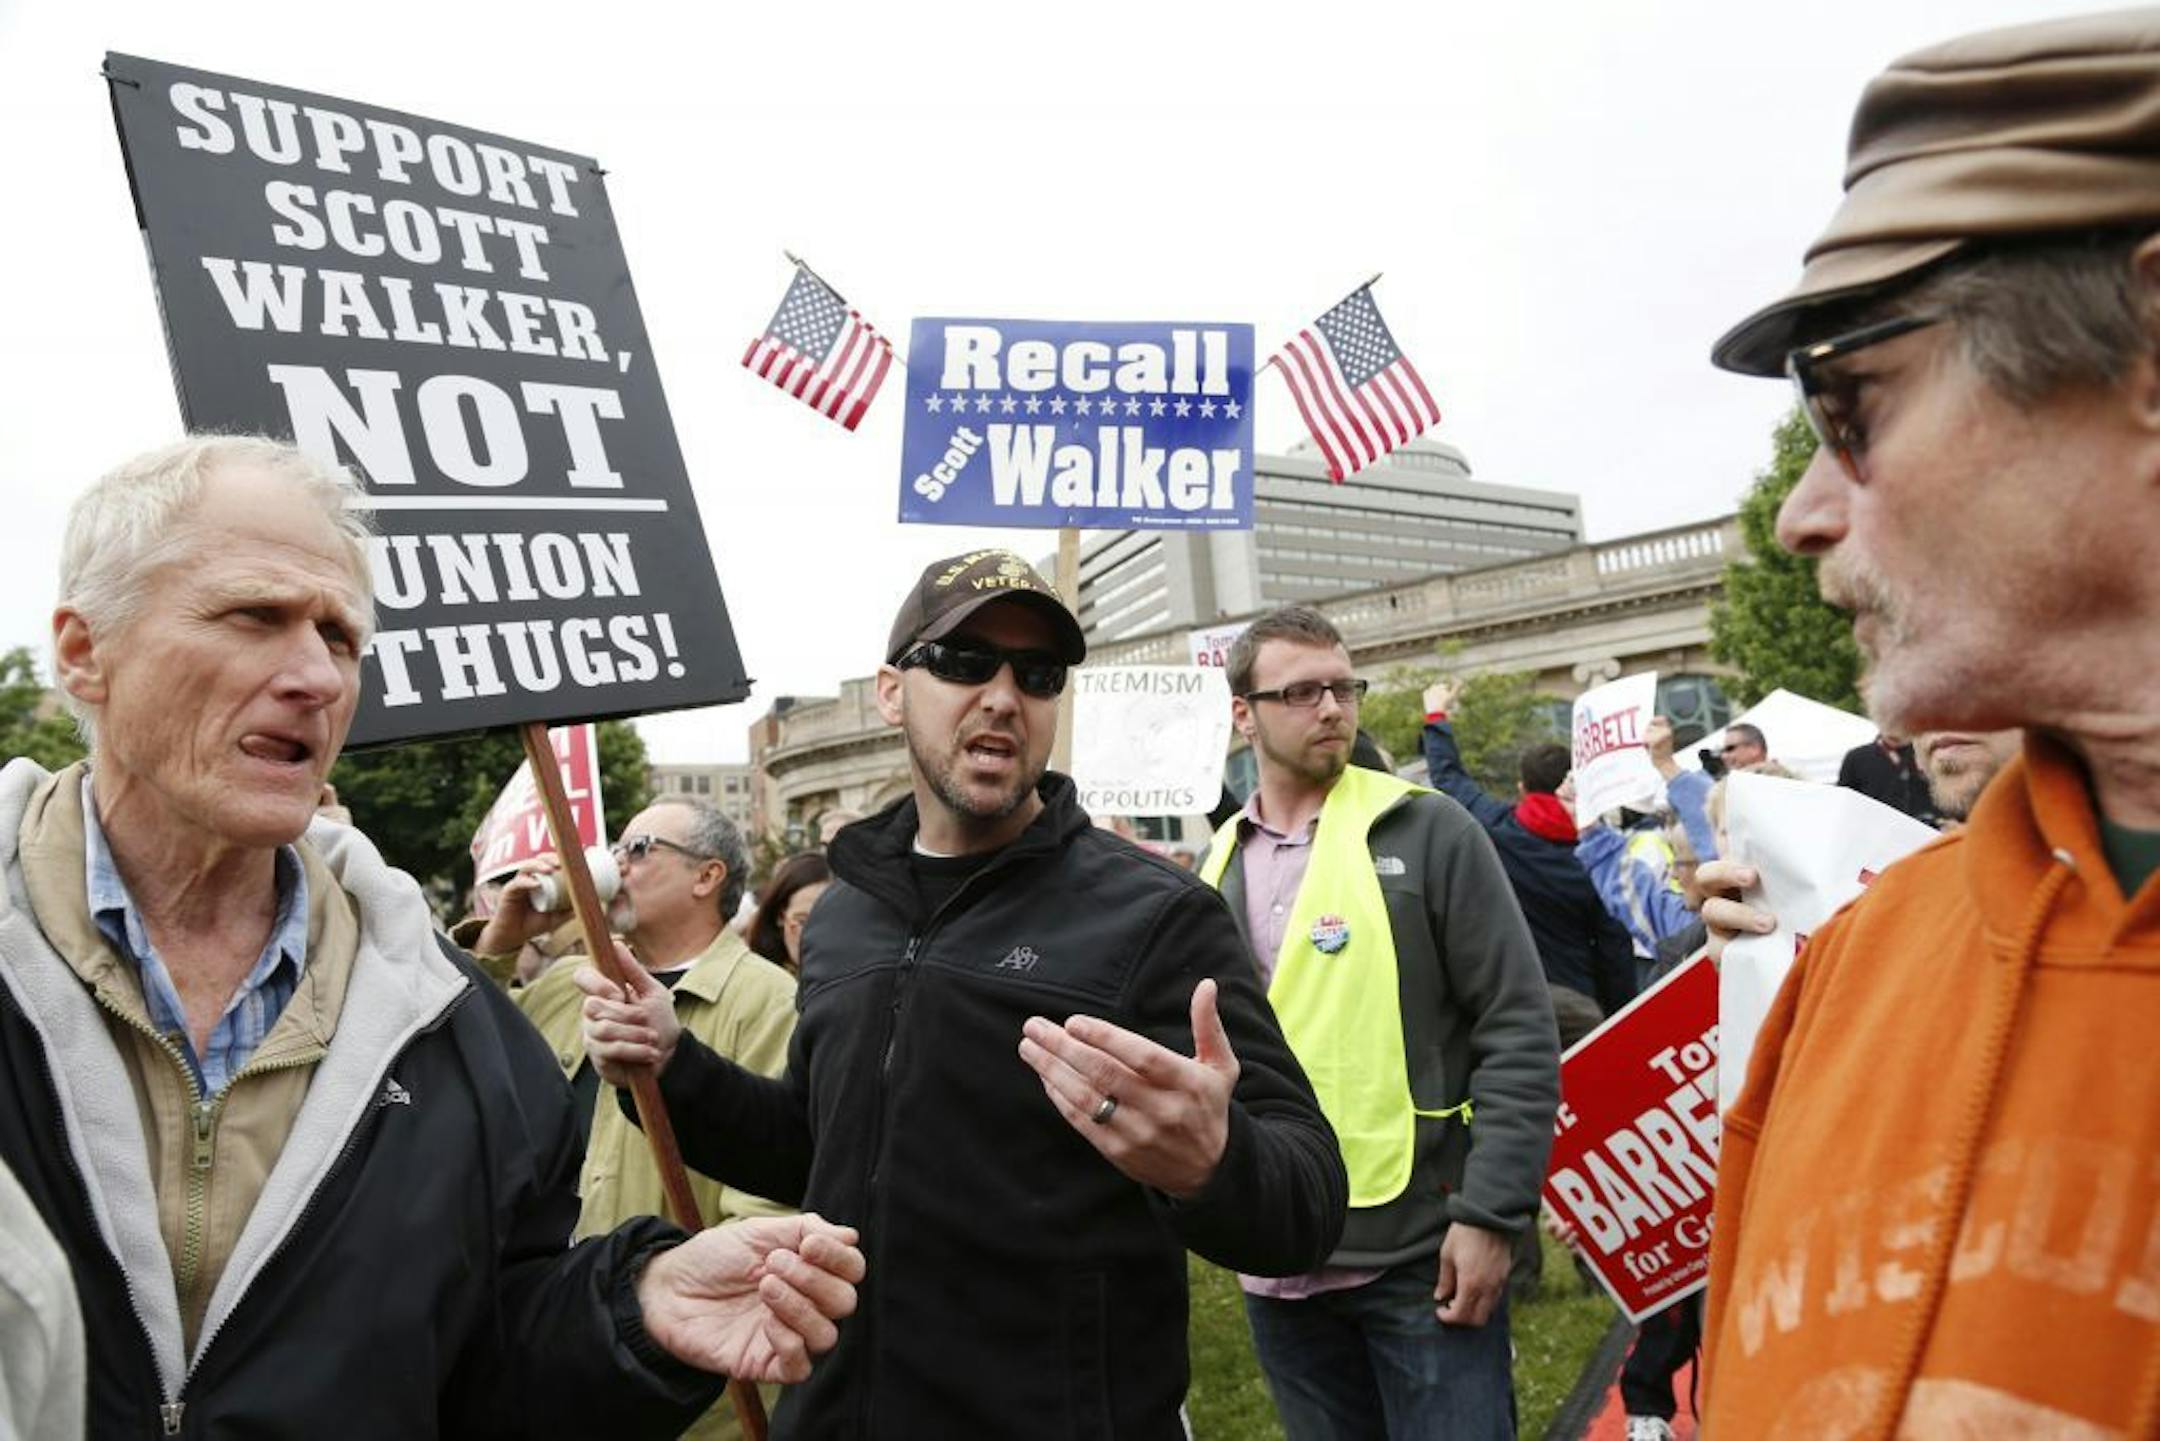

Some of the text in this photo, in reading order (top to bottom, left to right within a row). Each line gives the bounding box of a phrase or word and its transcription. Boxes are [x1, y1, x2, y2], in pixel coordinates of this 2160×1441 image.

[169, 81, 579, 218] SUPPORT
[265, 180, 550, 282] SCOTT
[201, 256, 632, 373] WALKER,
[940, 326, 1230, 396] Recall
[268, 363, 626, 488] NOT
[913, 424, 984, 503] Scott
[986, 423, 1242, 511] Walker
[367, 532, 641, 609] UNION
[361, 612, 687, 708] THUGS!
[1102, 785, 1195, 810] POLITICS
[1623, 1241, 1673, 1282] for
